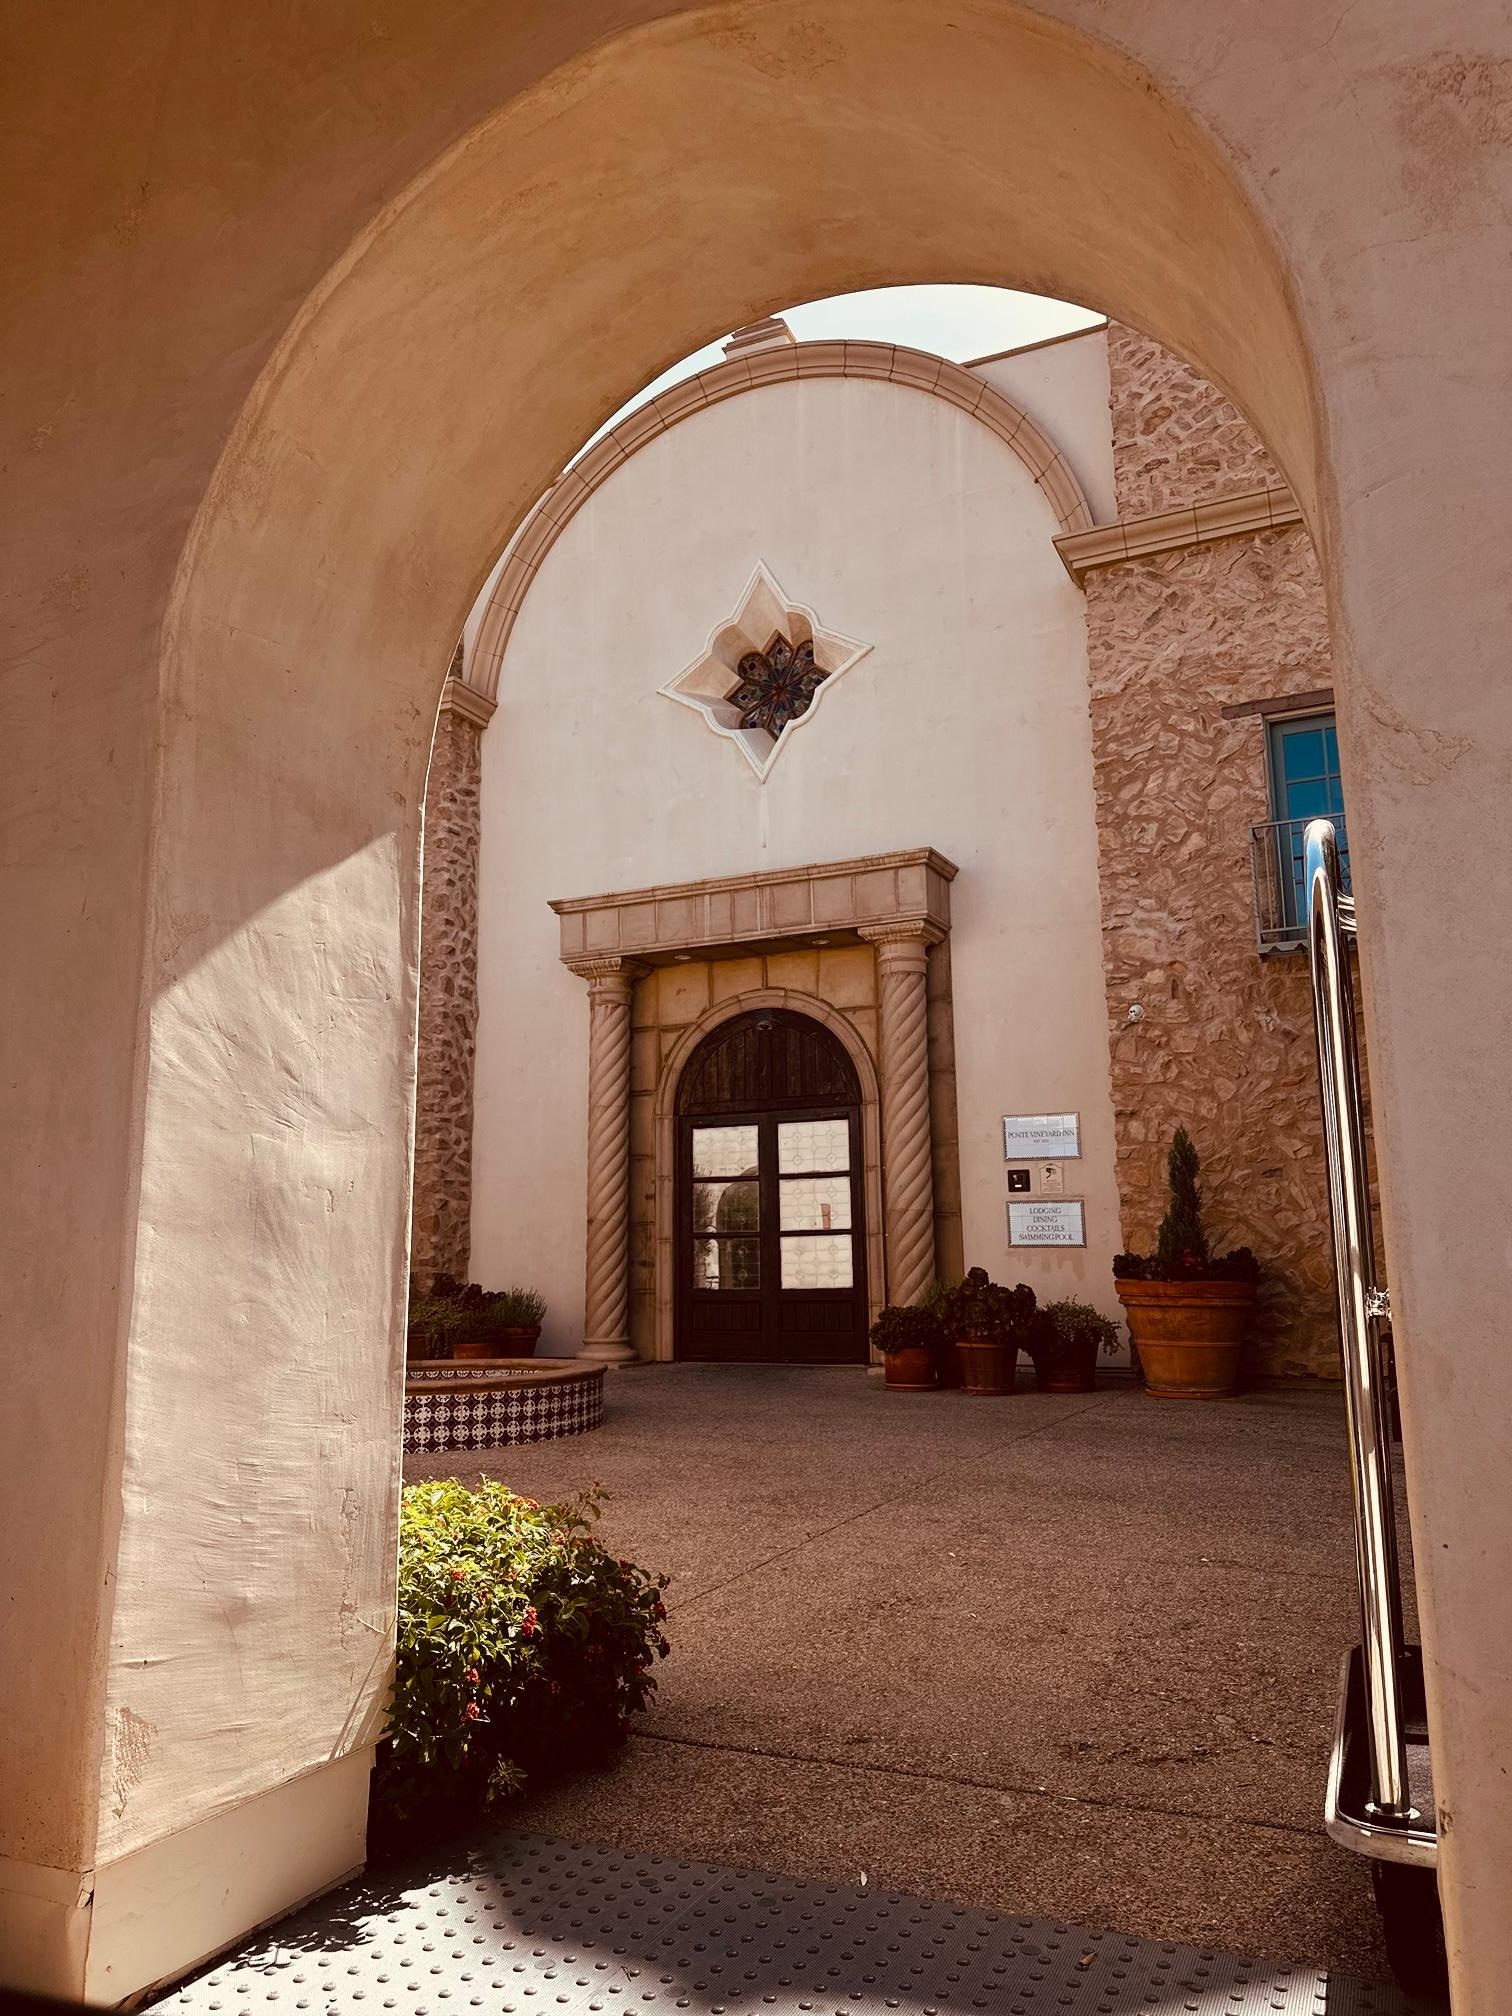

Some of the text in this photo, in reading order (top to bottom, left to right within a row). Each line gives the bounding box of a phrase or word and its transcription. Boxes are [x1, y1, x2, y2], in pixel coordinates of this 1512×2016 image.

[1063, 1129, 1075, 1137] INN
[1026, 1224, 1065, 1232] COCKTAILS
[1019, 1233, 1073, 1241] SWIMMING POOL
